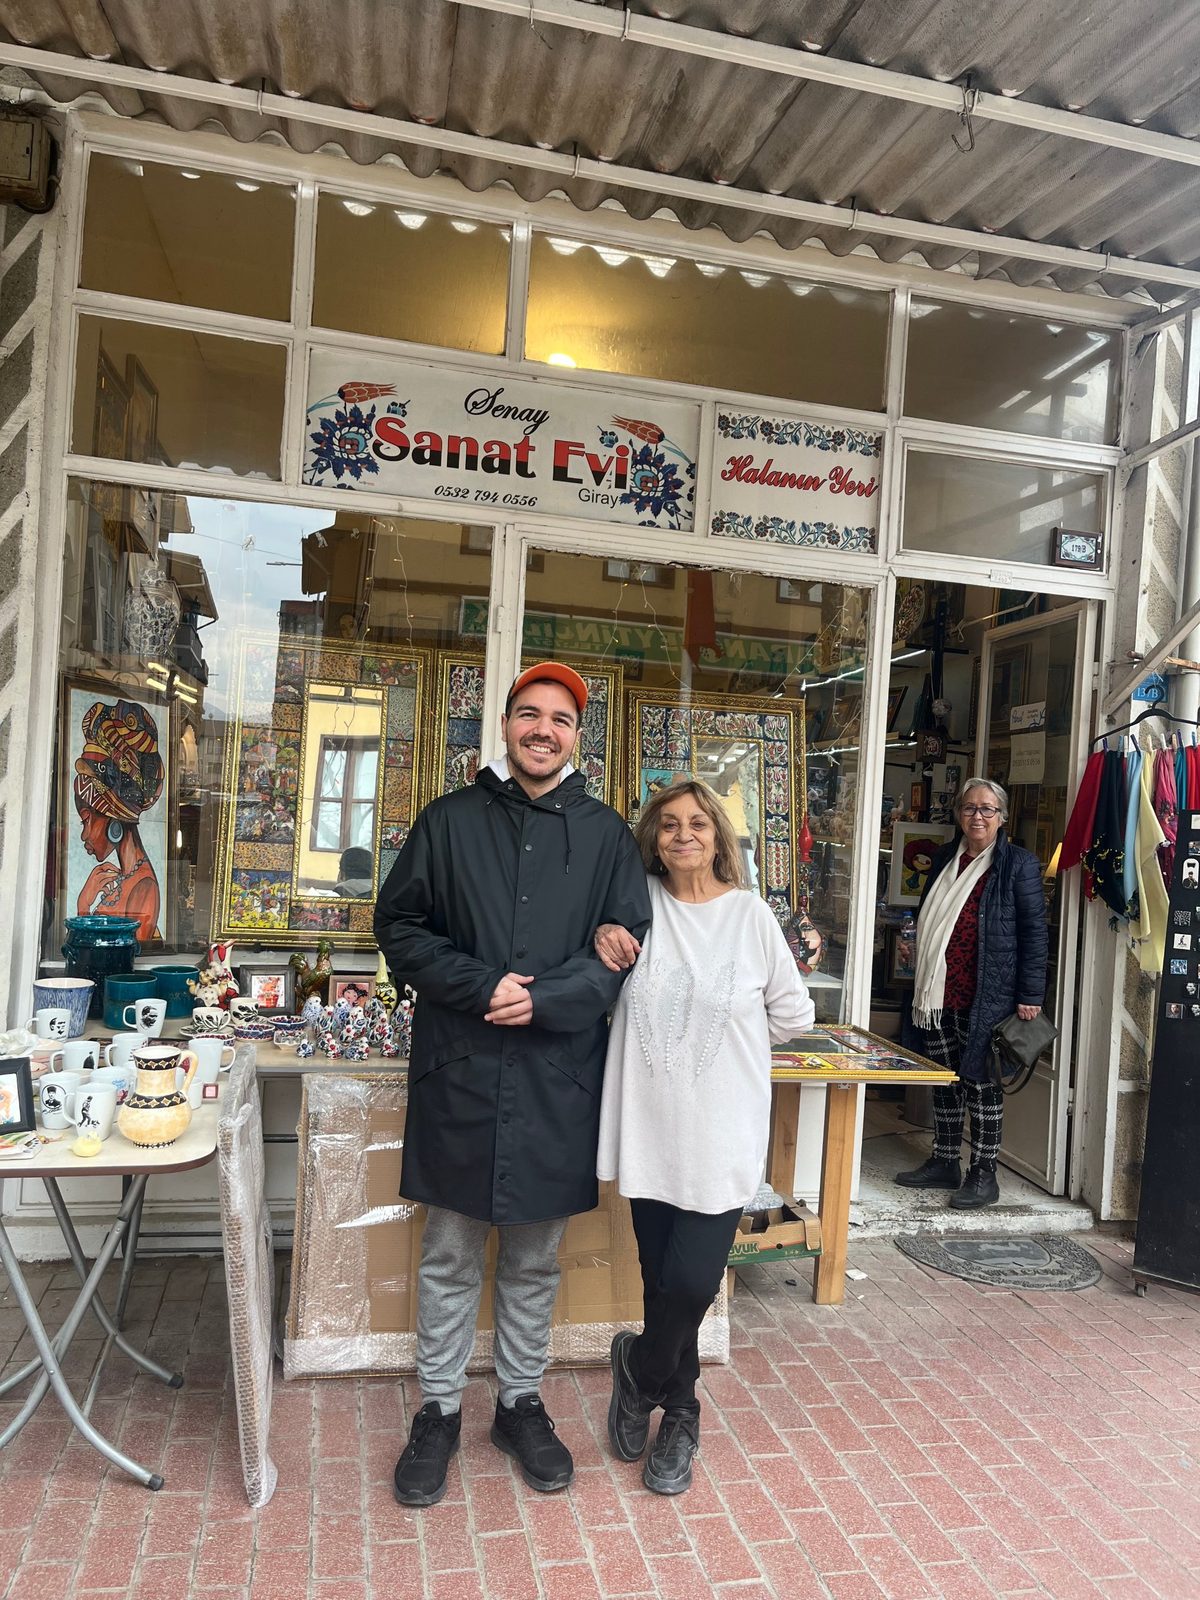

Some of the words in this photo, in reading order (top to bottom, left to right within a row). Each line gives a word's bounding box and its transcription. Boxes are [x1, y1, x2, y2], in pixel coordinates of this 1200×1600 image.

[372, 416, 537, 479] Sanat
[552, 439, 630, 490] Evi
[721, 454, 827, 491] Halanın
[828, 465, 879, 498] Yeri
[434, 485, 470, 499] 0532
[474, 489, 499, 504] 794
[502, 493, 538, 507] 0556
[577, 487, 619, 508] Giray
